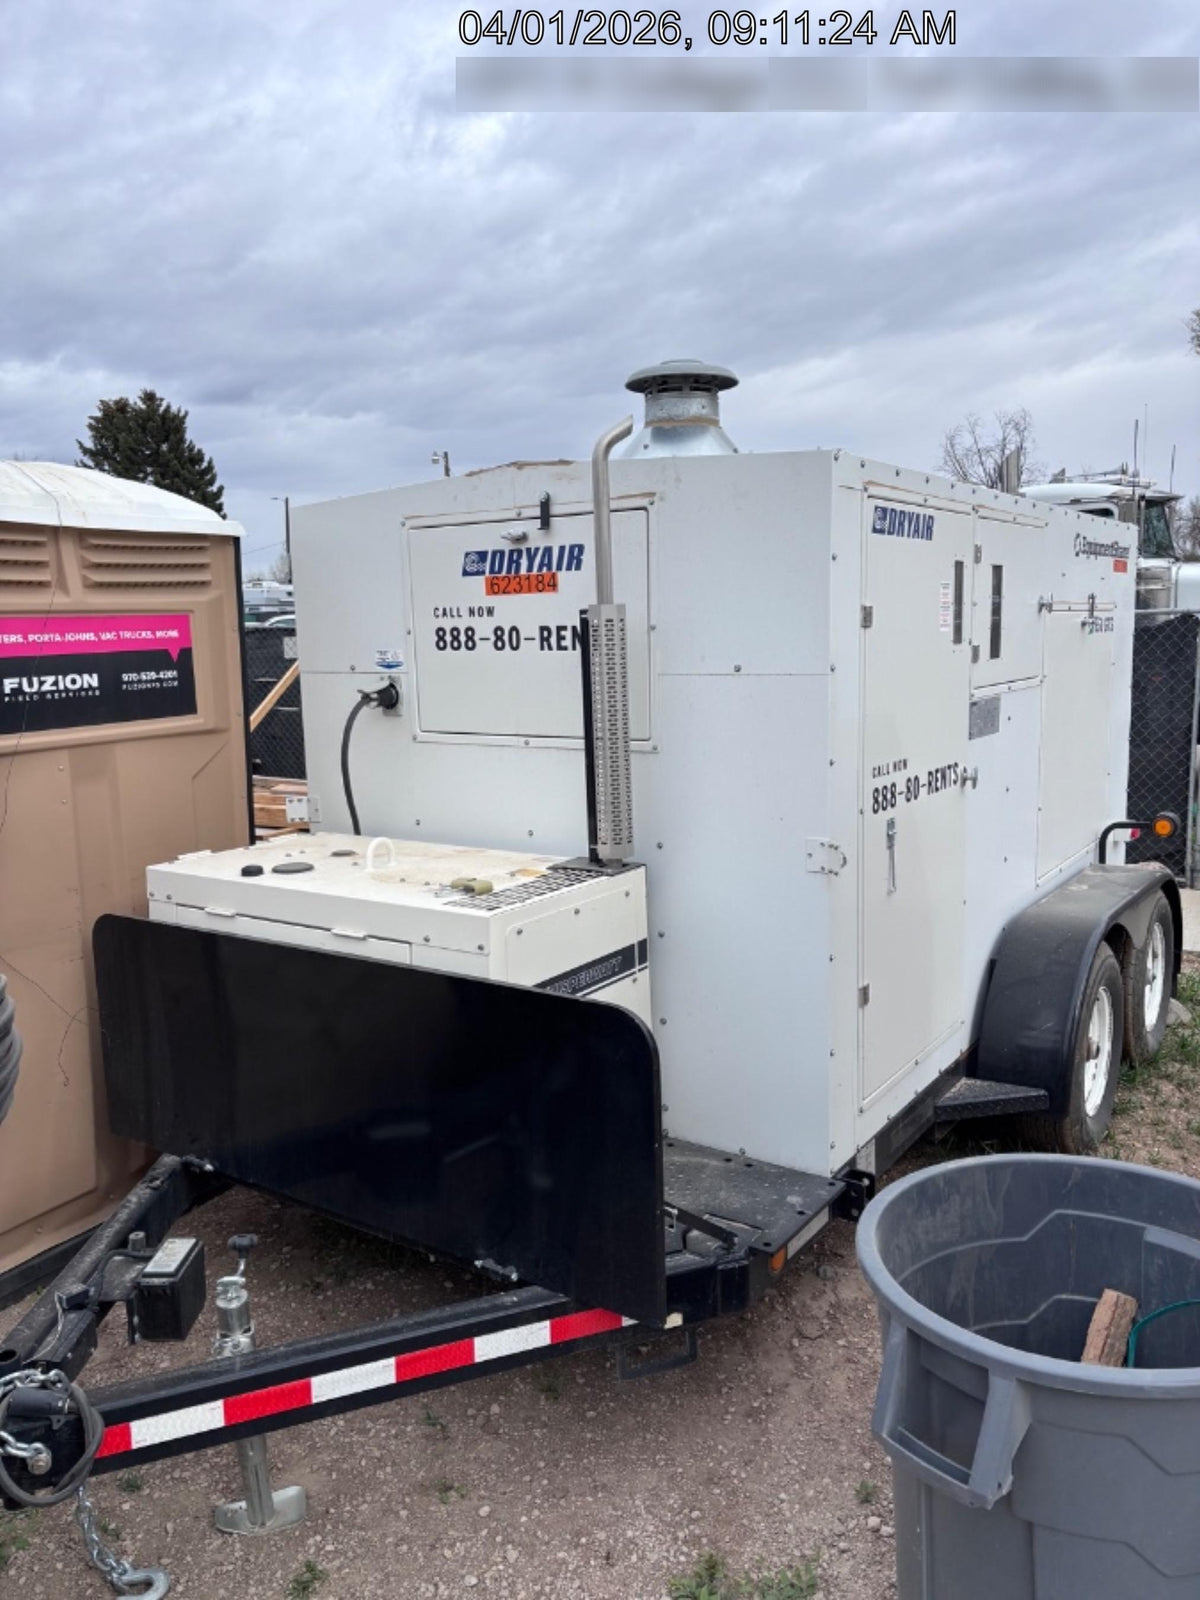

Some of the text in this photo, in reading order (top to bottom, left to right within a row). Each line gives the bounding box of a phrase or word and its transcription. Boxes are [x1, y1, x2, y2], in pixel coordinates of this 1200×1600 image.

[887, 508, 935, 541] DRYAIR
[489, 544, 585, 574] DRYAIR
[490, 573, 558, 595] 623184
[433, 605, 496, 618] CALL NOW
[3, 673, 99, 694] FUZION
[872, 762, 890, 779] CALL
[872, 761, 959, 815] 888-80-RENTS
